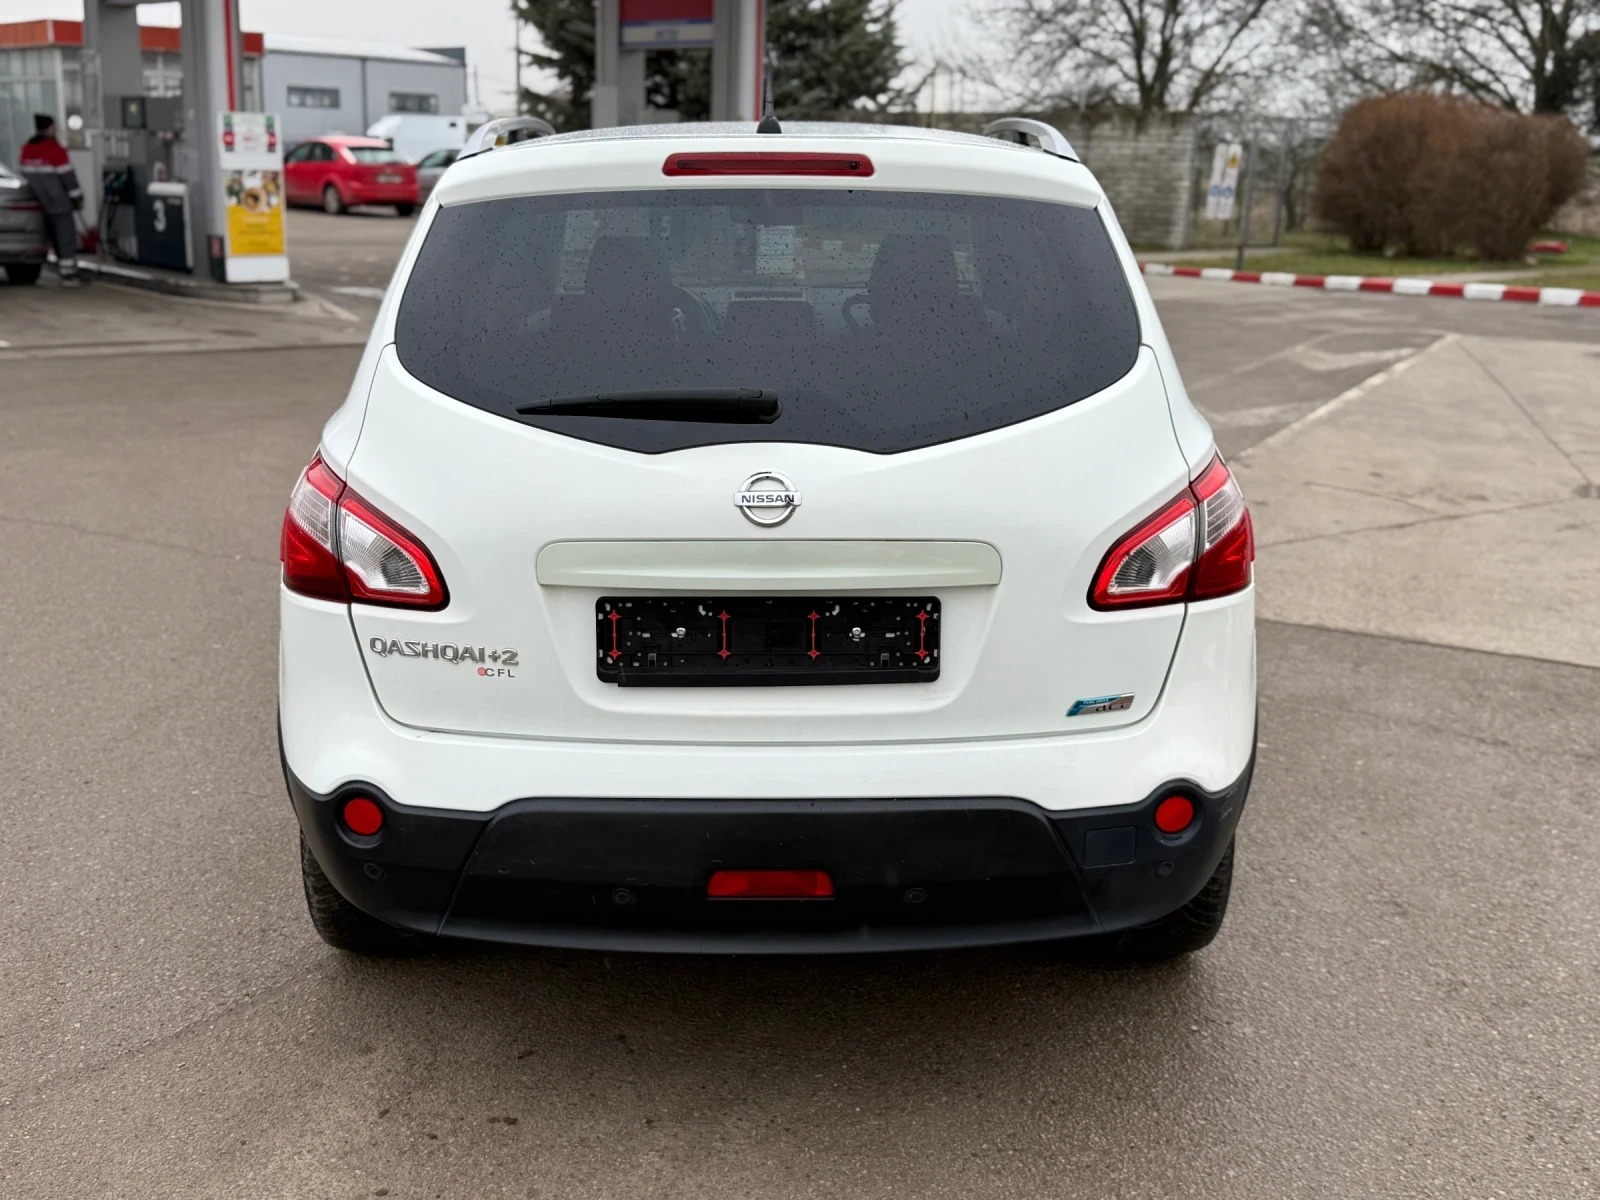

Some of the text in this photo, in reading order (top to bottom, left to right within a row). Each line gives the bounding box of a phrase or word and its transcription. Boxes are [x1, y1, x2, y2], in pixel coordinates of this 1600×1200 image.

[153, 199, 167, 232] 3
[741, 494, 795, 503] NISSAN
[369, 635, 519, 666] QASHQAI+2
